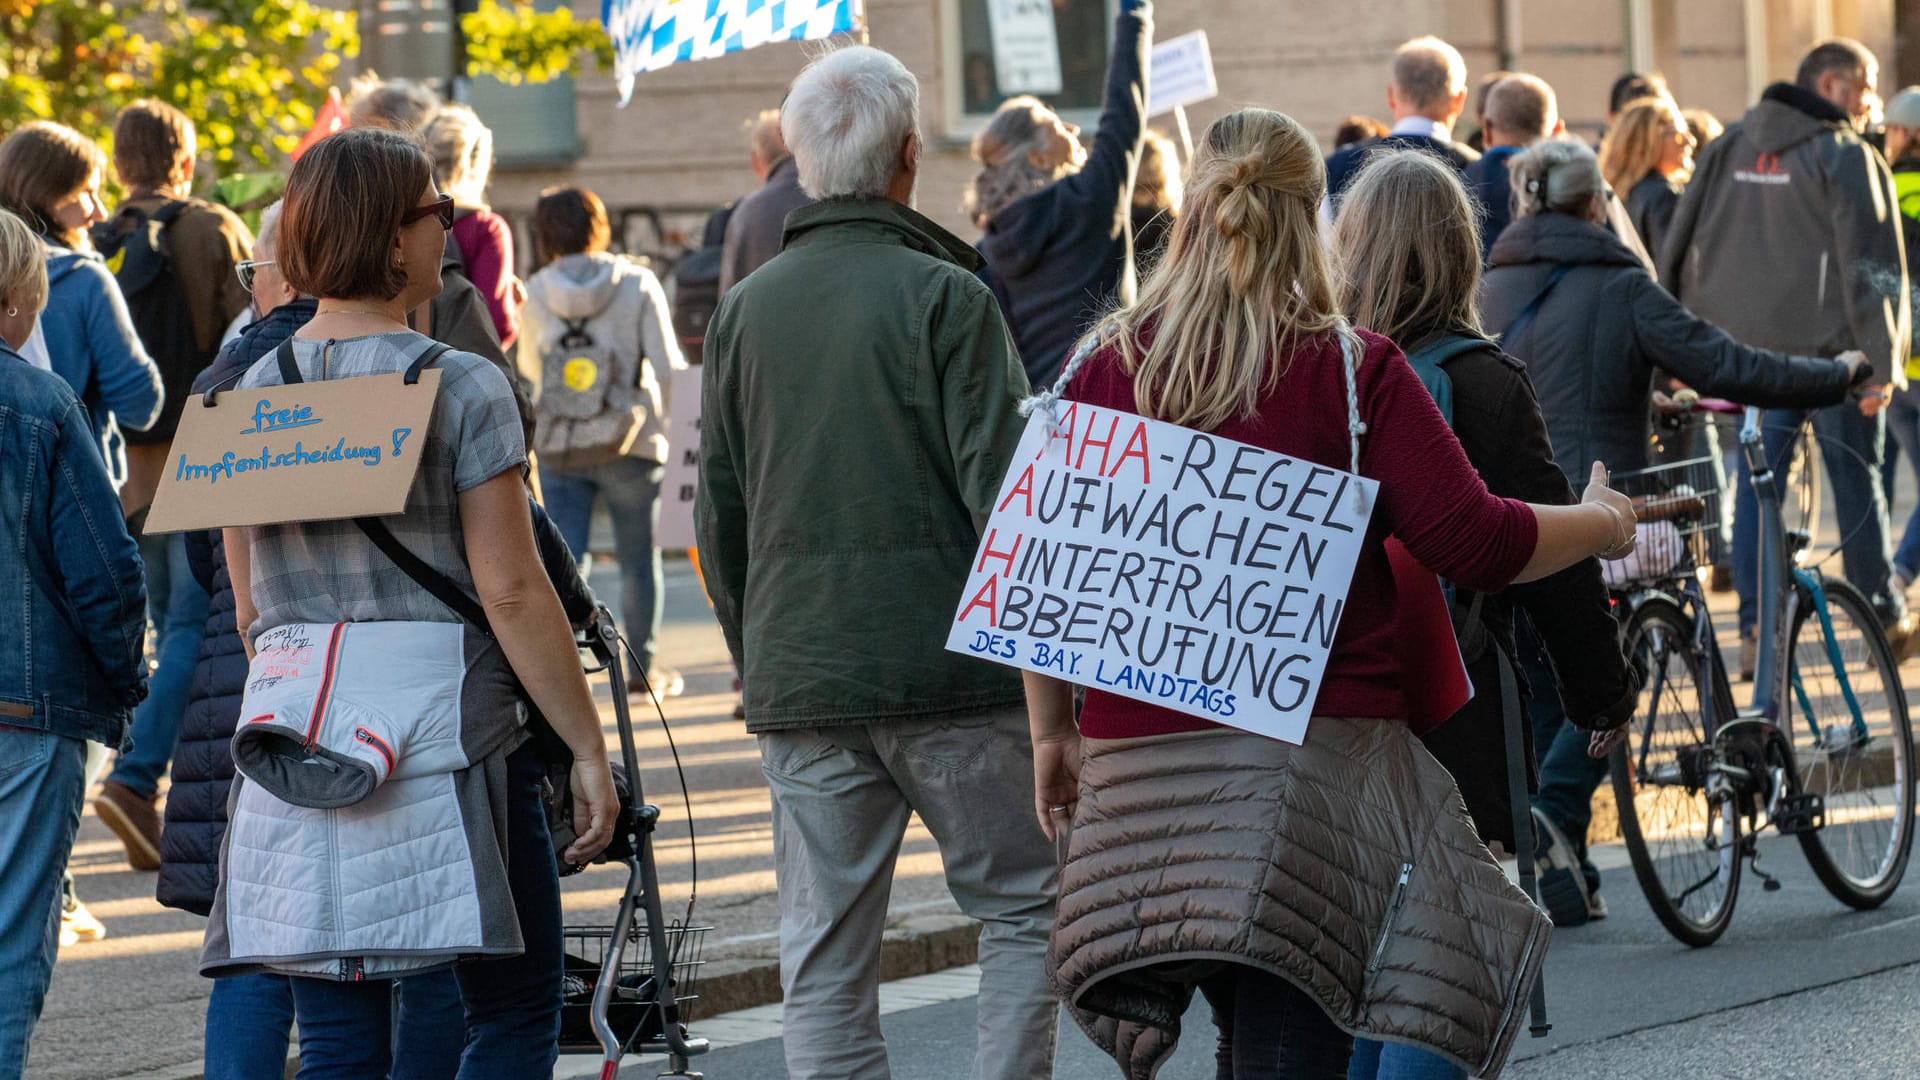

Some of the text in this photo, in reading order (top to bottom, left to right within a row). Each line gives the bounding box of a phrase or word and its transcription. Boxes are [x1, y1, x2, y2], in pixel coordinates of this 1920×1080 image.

[176, 437, 381, 483] Impfentscheidung
[251, 399, 313, 432] freie
[1036, 402, 1353, 534] AHA-REGEL
[998, 463, 1328, 581] AUFWACHEN
[958, 572, 1312, 713] ABBERUFUNG
[976, 528, 1343, 650] HINTERFRAGEN
[968, 630, 1236, 717] DES BAY. LANDTAGS
